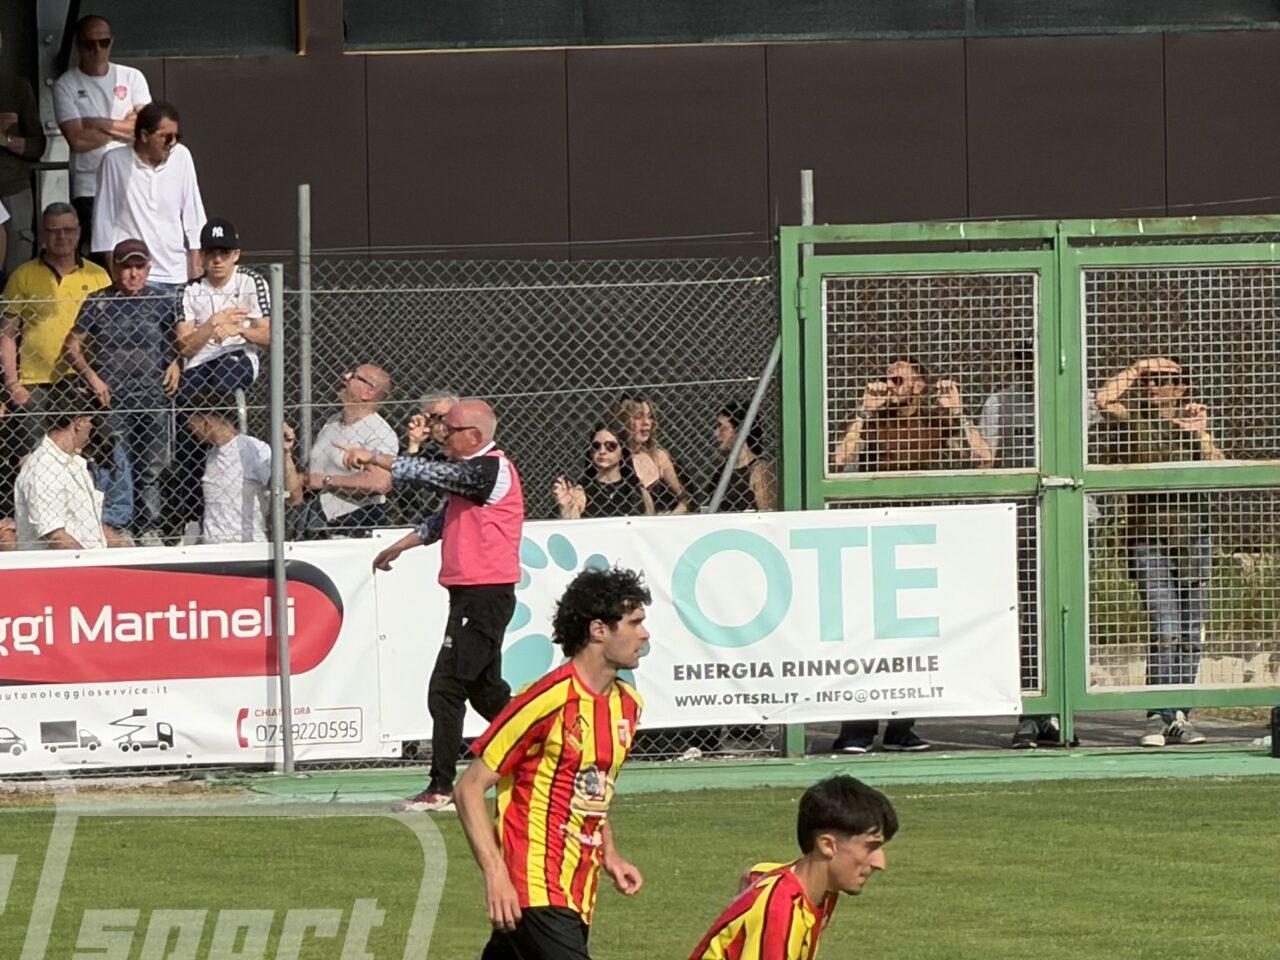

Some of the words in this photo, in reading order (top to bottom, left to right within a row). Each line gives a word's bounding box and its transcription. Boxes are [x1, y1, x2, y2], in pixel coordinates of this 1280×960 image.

[671, 523, 940, 648] OTE
[70, 596, 295, 644] Martineli
[673, 661, 775, 681] ENERGIA
[782, 655, 939, 678] RINNOVABILE
[675, 692, 799, 707] WWW.OTESRL.IT
[816, 686, 945, 703] INFO@OTESRL.IT
[254, 708, 283, 718] CHIA
[293, 706, 311, 716] ORA
